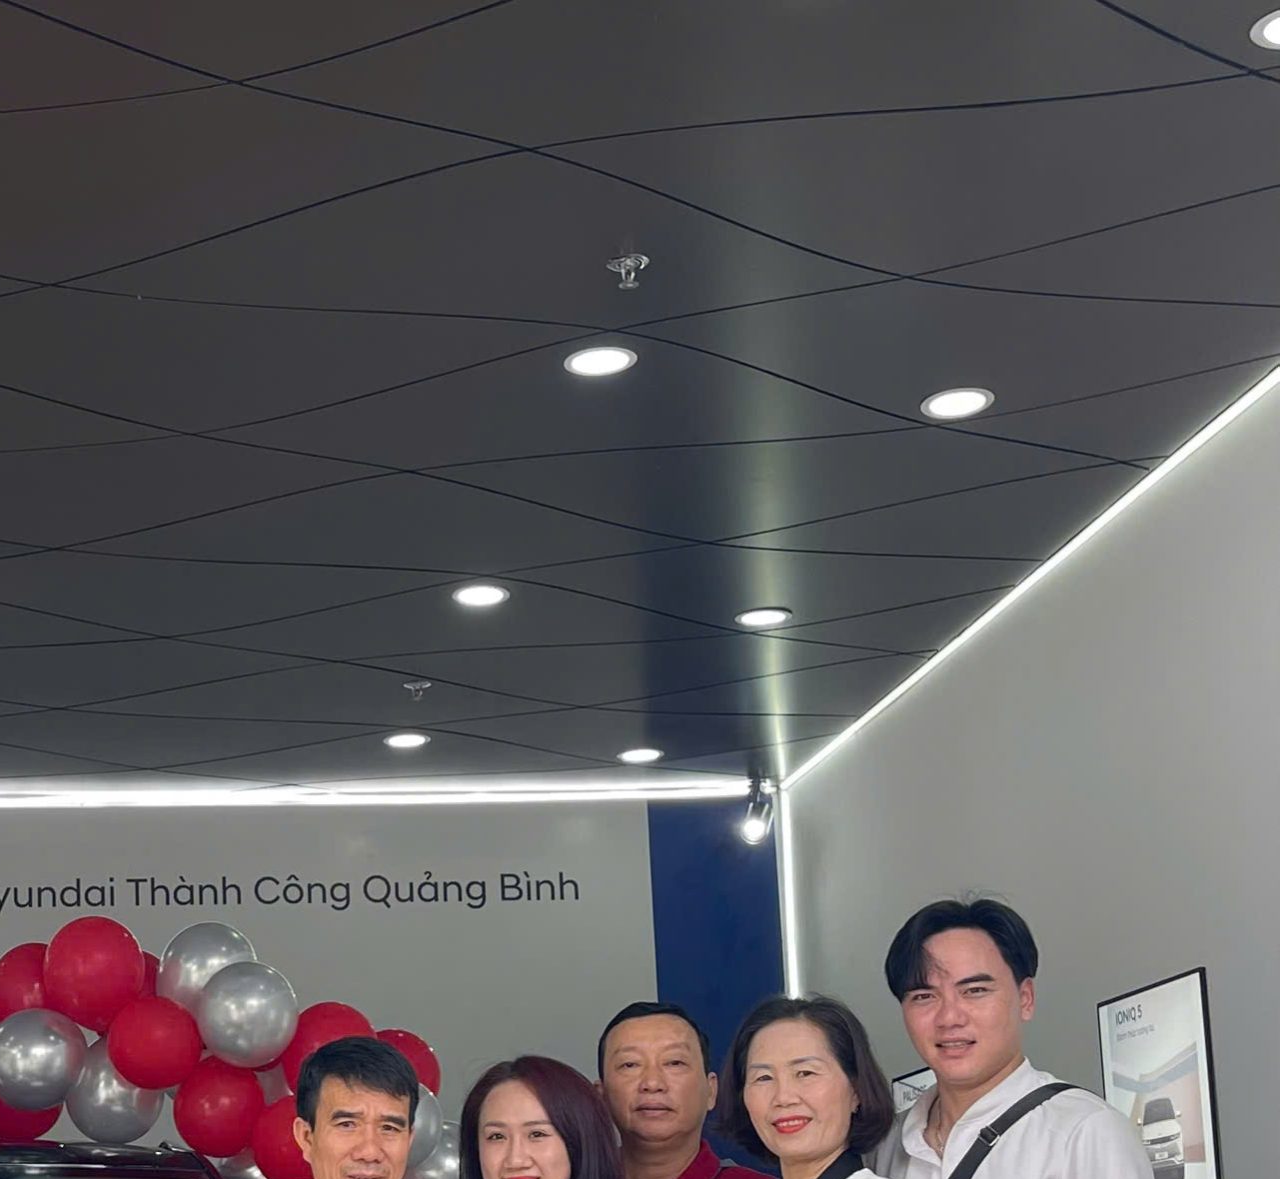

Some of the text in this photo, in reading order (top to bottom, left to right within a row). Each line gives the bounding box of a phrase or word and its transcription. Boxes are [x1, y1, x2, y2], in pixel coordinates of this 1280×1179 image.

[125, 875, 242, 907] Thành
[253, 874, 351, 911] Công
[362, 870, 487, 910] Quảng
[499, 871, 580, 902] Bình
[1137, 1004, 1143, 1019] 5
